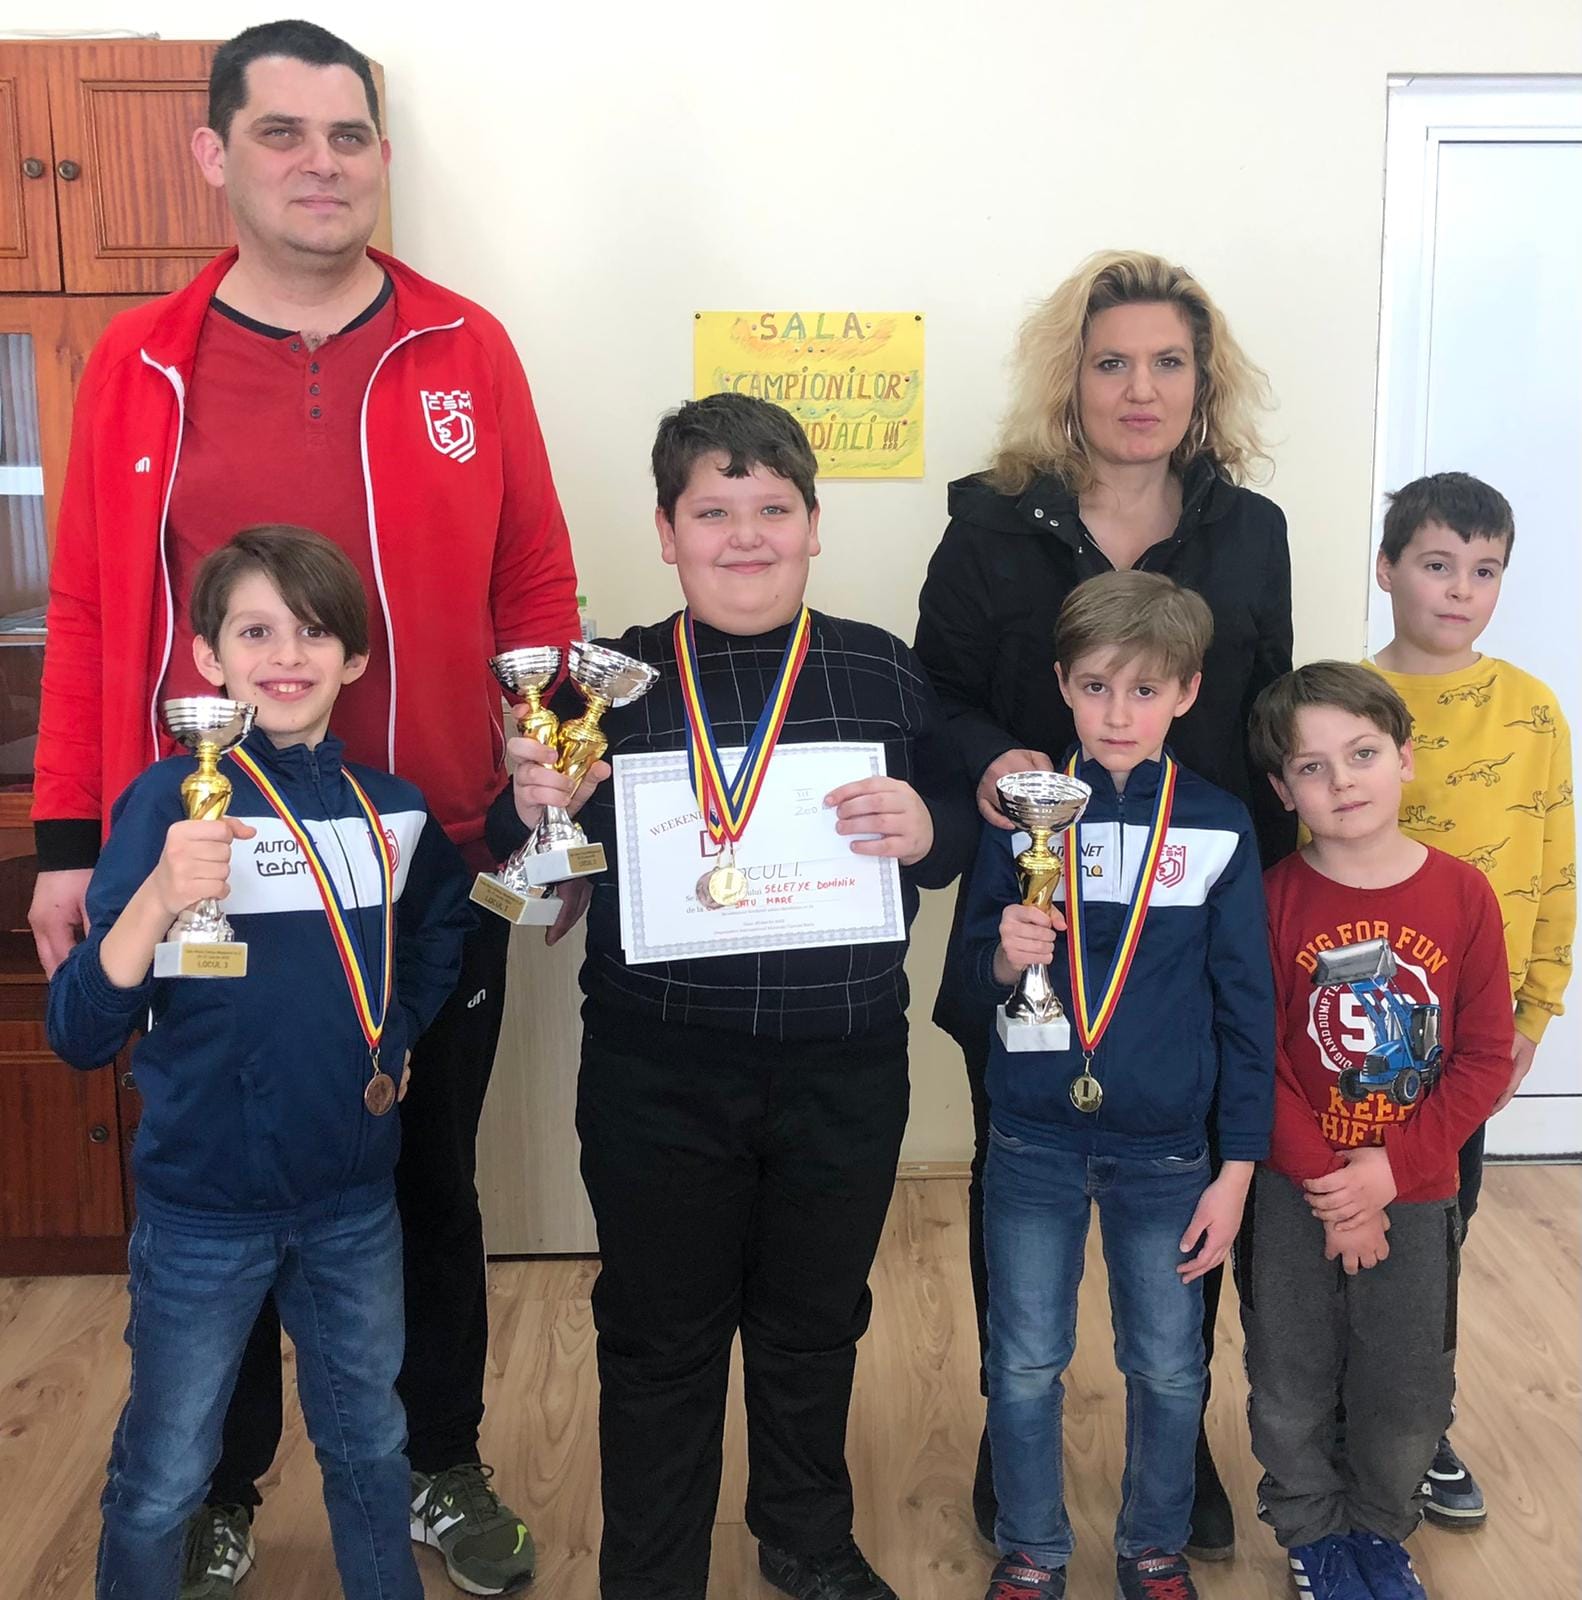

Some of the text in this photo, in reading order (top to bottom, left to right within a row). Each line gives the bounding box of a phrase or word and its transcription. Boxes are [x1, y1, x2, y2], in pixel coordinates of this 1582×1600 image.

[760, 312, 866, 340] SALA
[428, 399, 472, 411] CSM
[804, 414, 877, 450] DIALI
[254, 839, 318, 855] AUTO
[1296, 920, 1449, 975] DIG FOR FUN
[1320, 1112, 1385, 1146] HIFT
